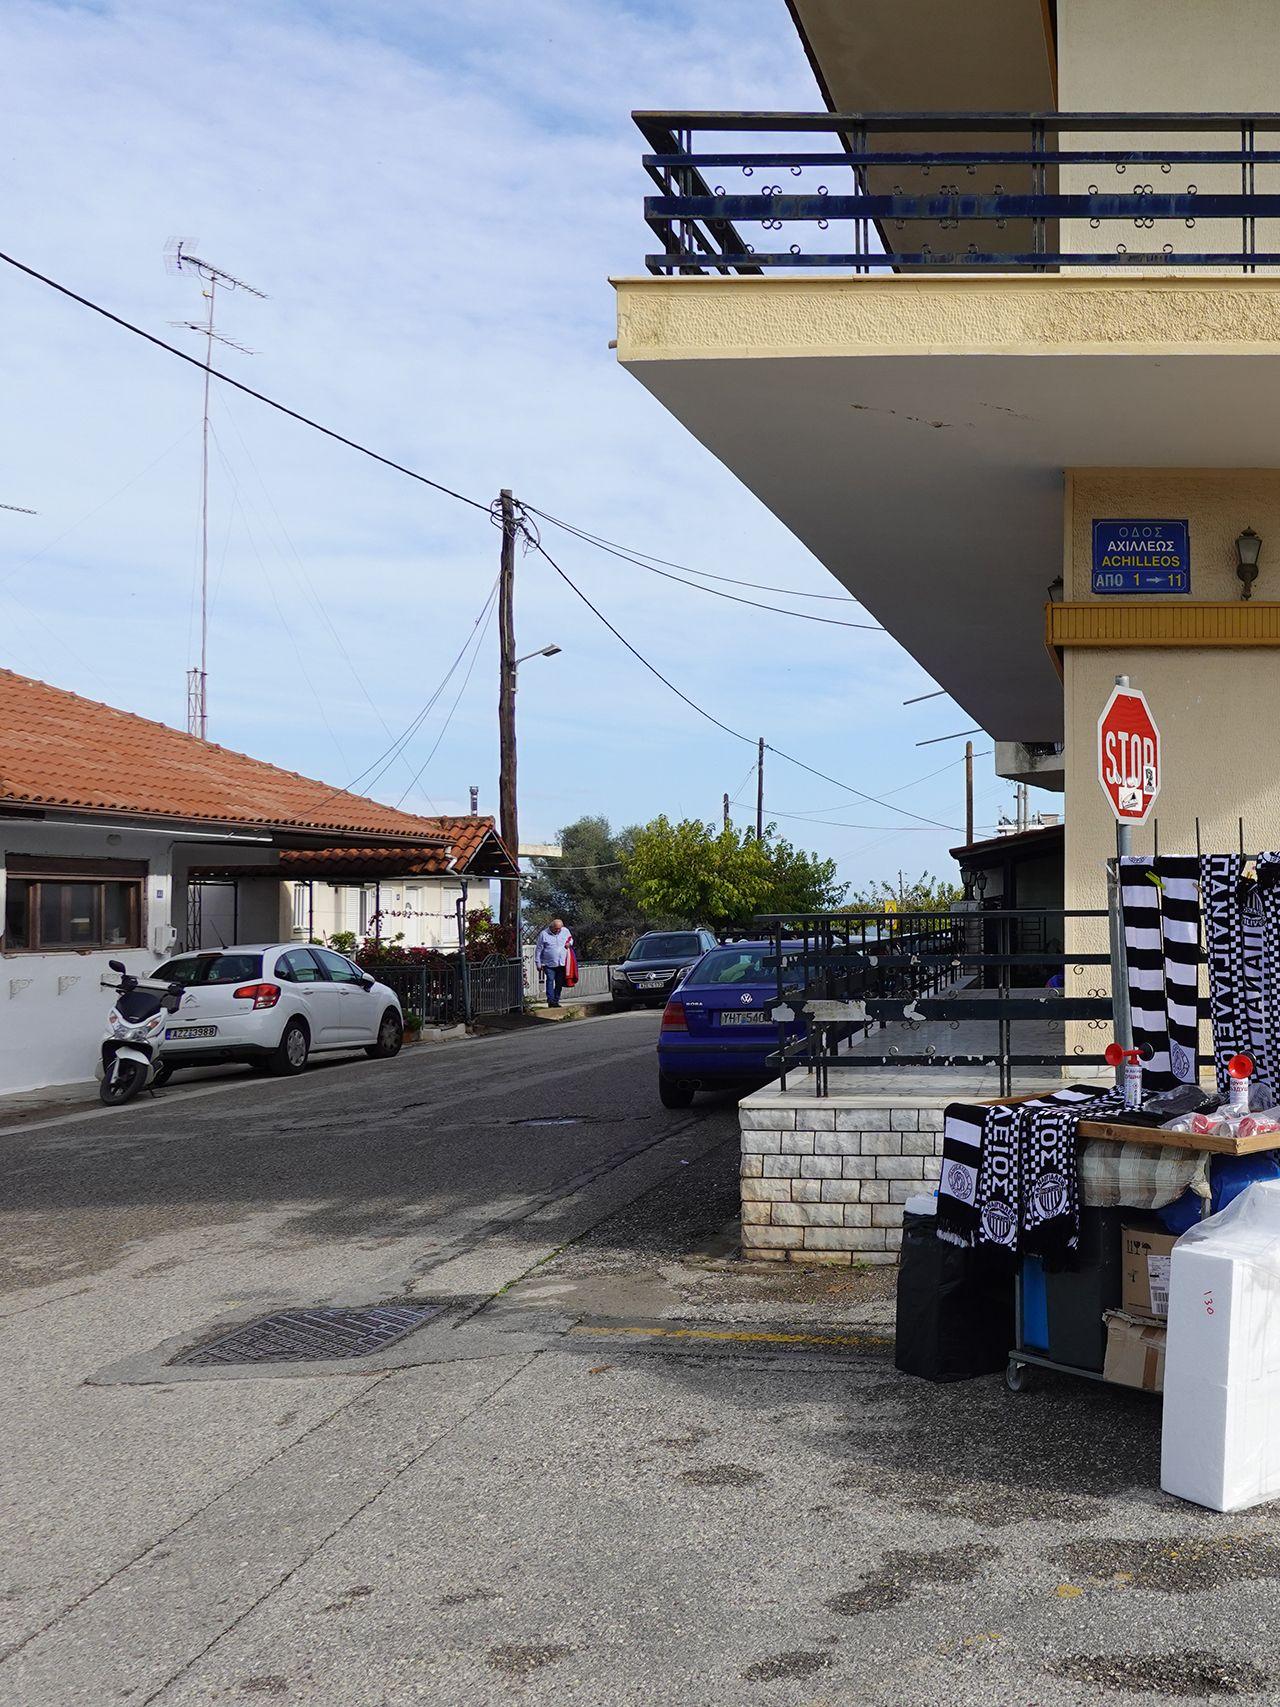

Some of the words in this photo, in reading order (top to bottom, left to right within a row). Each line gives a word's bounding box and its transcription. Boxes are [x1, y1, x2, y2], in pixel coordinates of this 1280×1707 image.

[1119, 527, 1163, 538] ΟΔΟΣ
[1107, 540, 1175, 552] ΑΧΙΛΛΕΩΣ
[1102, 555, 1180, 567] ACHILLEOS
[1096, 573, 1123, 587] ΑΠΟ
[1134, 573, 1140, 586] 1
[1168, 574, 1182, 587] 11
[1105, 730, 1155, 789] STOP
